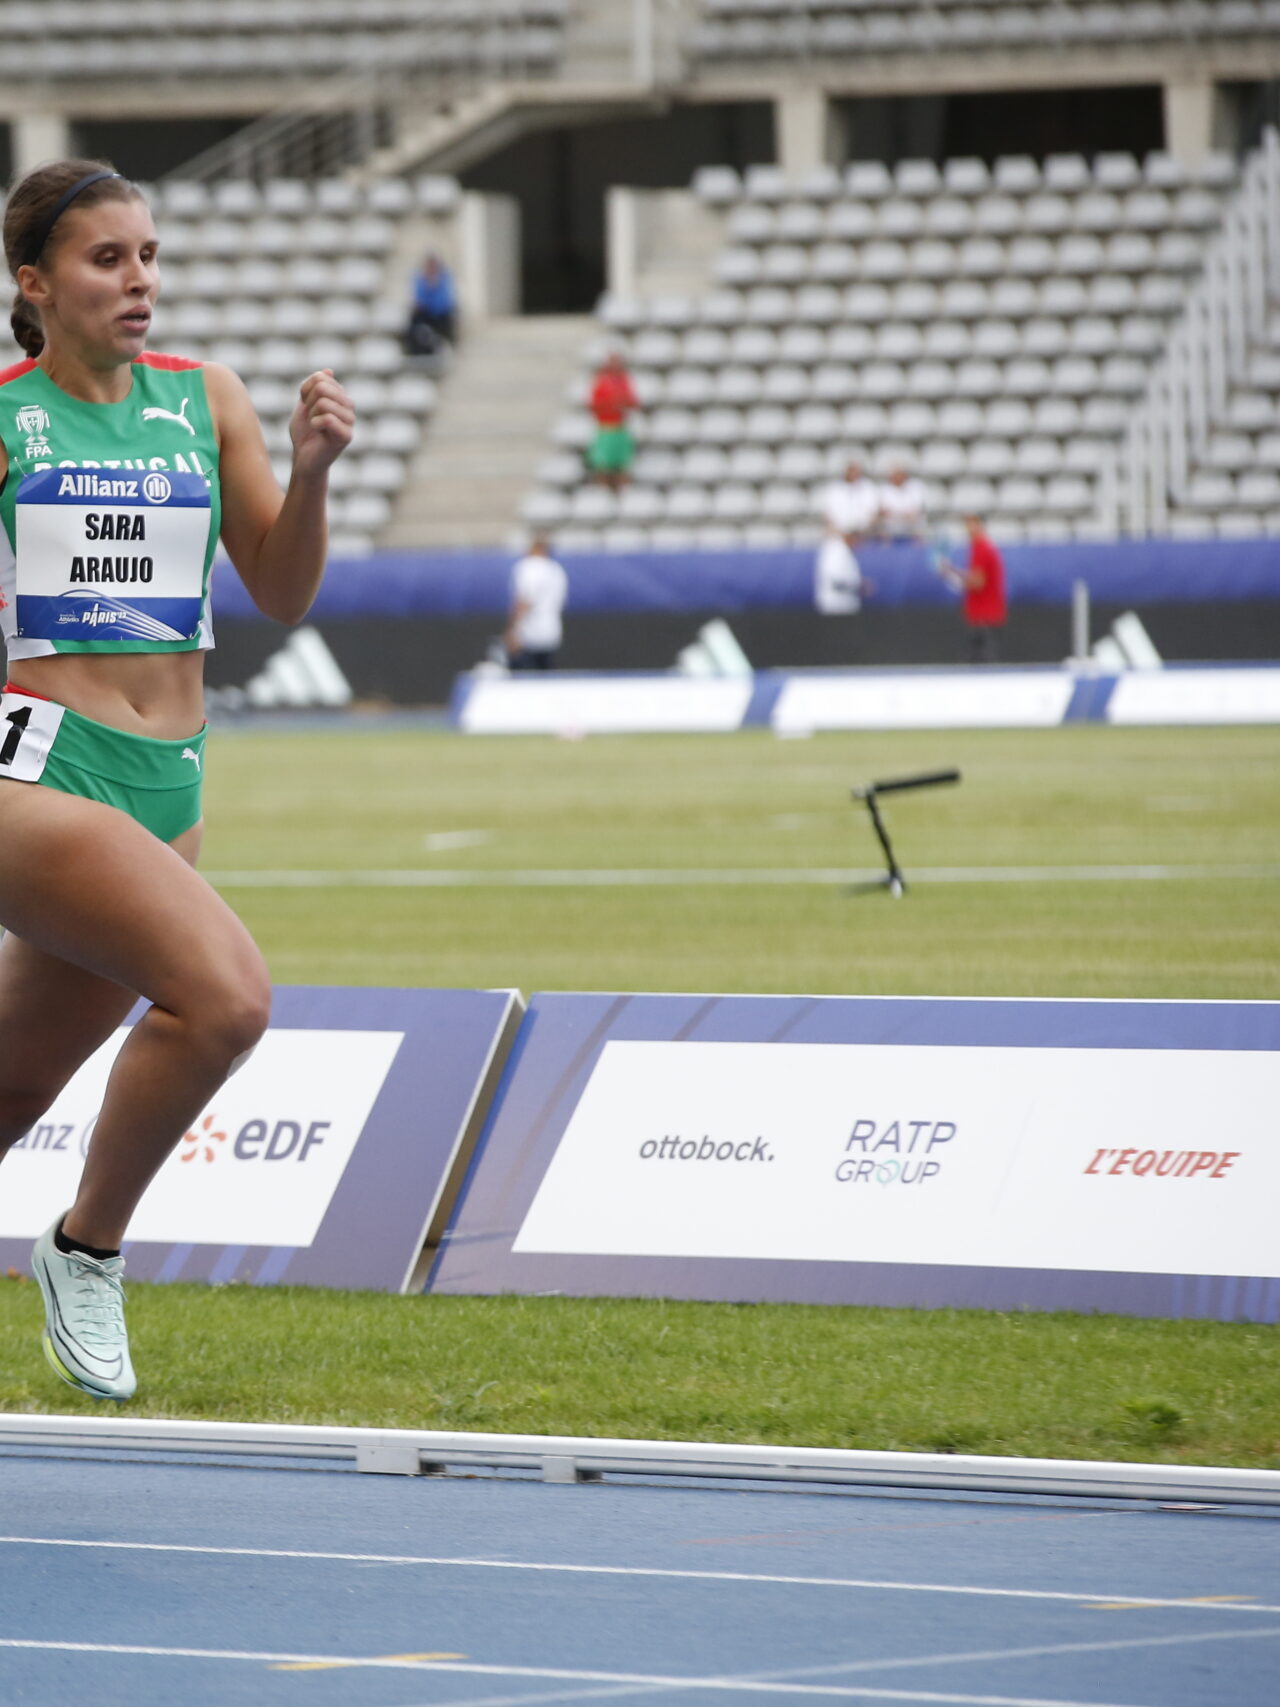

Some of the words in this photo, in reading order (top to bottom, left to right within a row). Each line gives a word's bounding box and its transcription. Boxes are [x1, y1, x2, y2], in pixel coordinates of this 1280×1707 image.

[25, 445, 53, 458] FPA
[58, 474, 138, 497] Allianz
[85, 513, 146, 541] SARA
[70, 556, 153, 583] ARAUJO
[845, 1119, 957, 1154] RATP
[835, 1159, 941, 1185] GROUP
